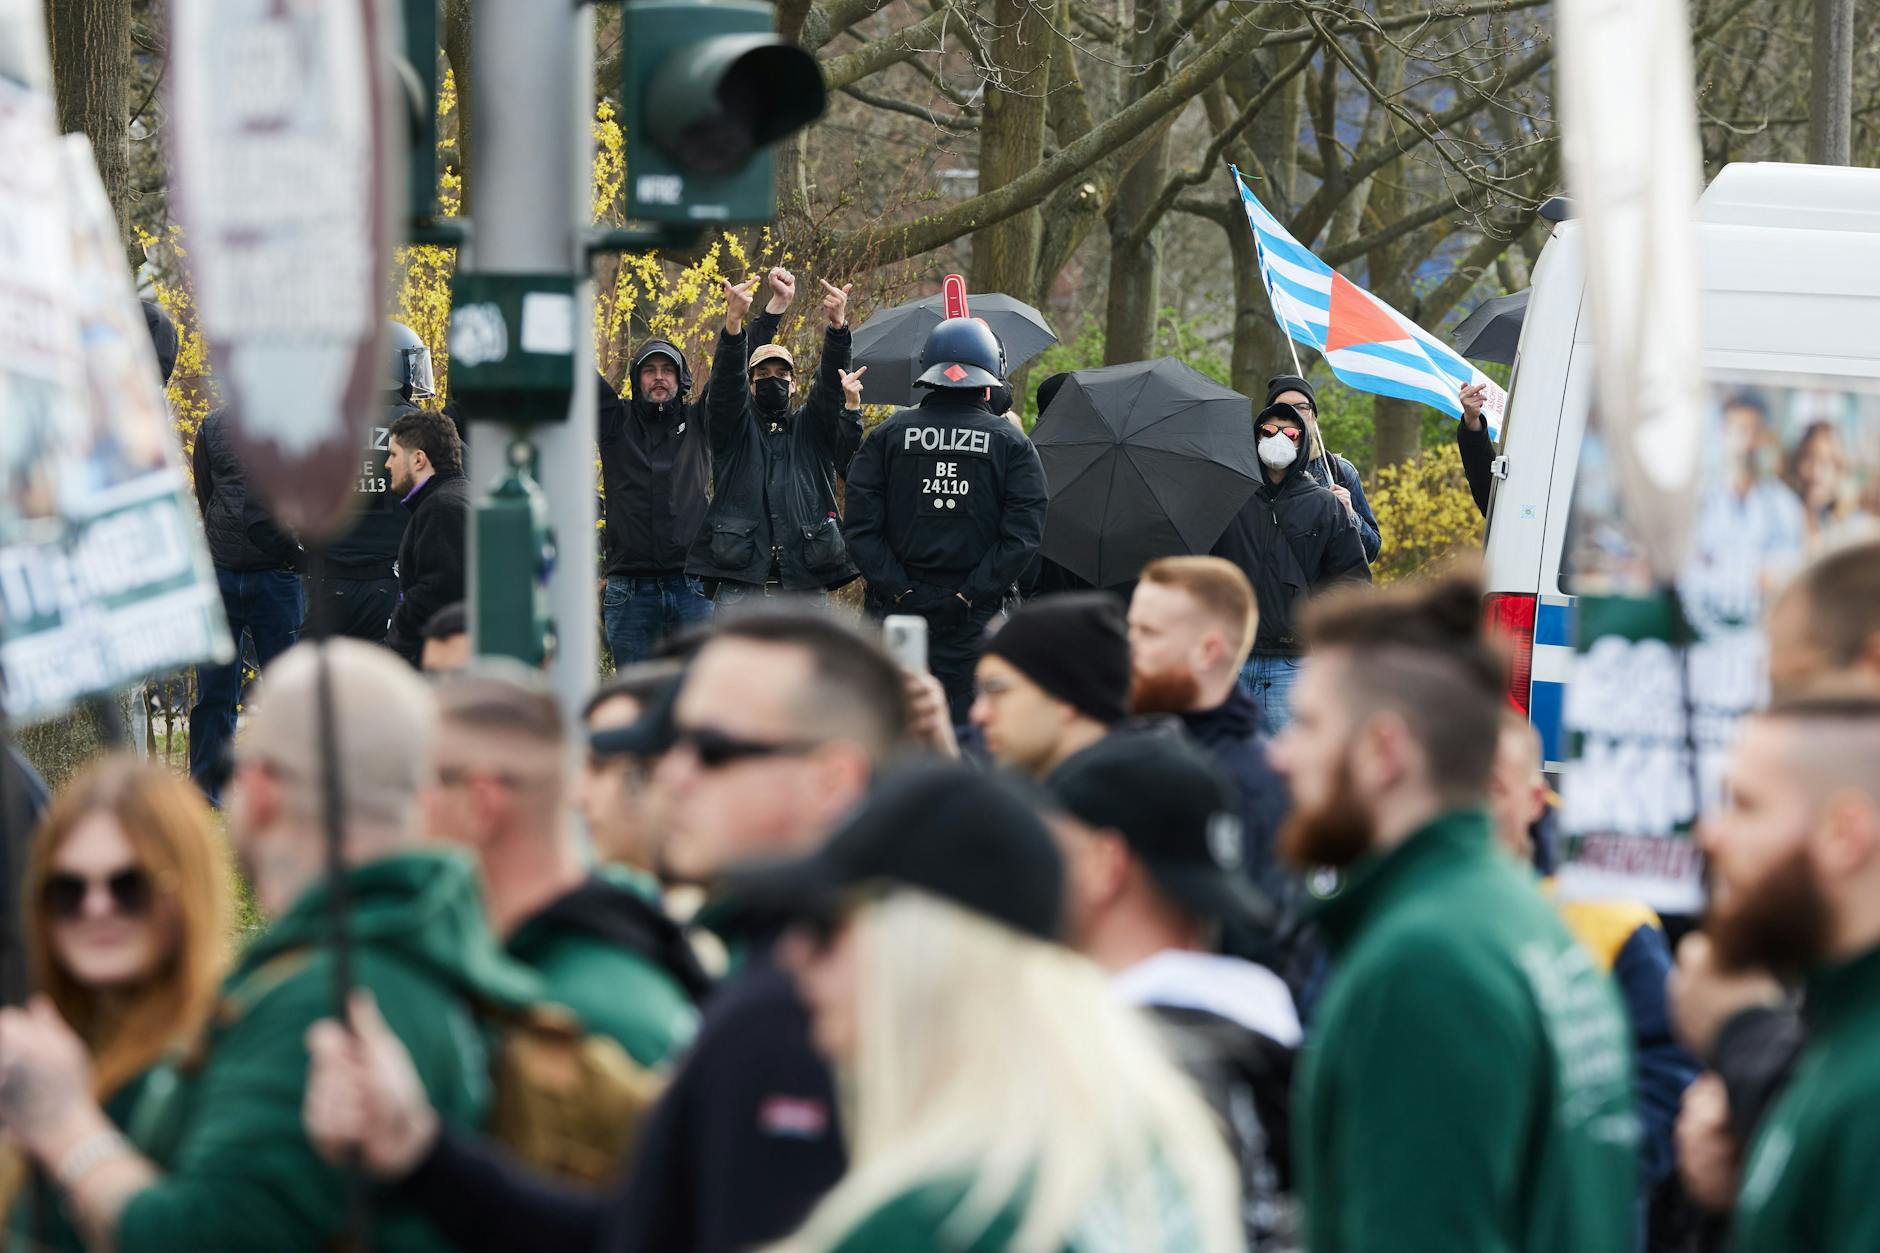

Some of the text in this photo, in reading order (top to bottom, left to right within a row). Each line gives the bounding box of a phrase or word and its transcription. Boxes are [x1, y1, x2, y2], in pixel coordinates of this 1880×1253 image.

[904, 427, 990, 454] POLIZEI
[935, 461, 958, 477] BE
[922, 478, 969, 495] 24110
